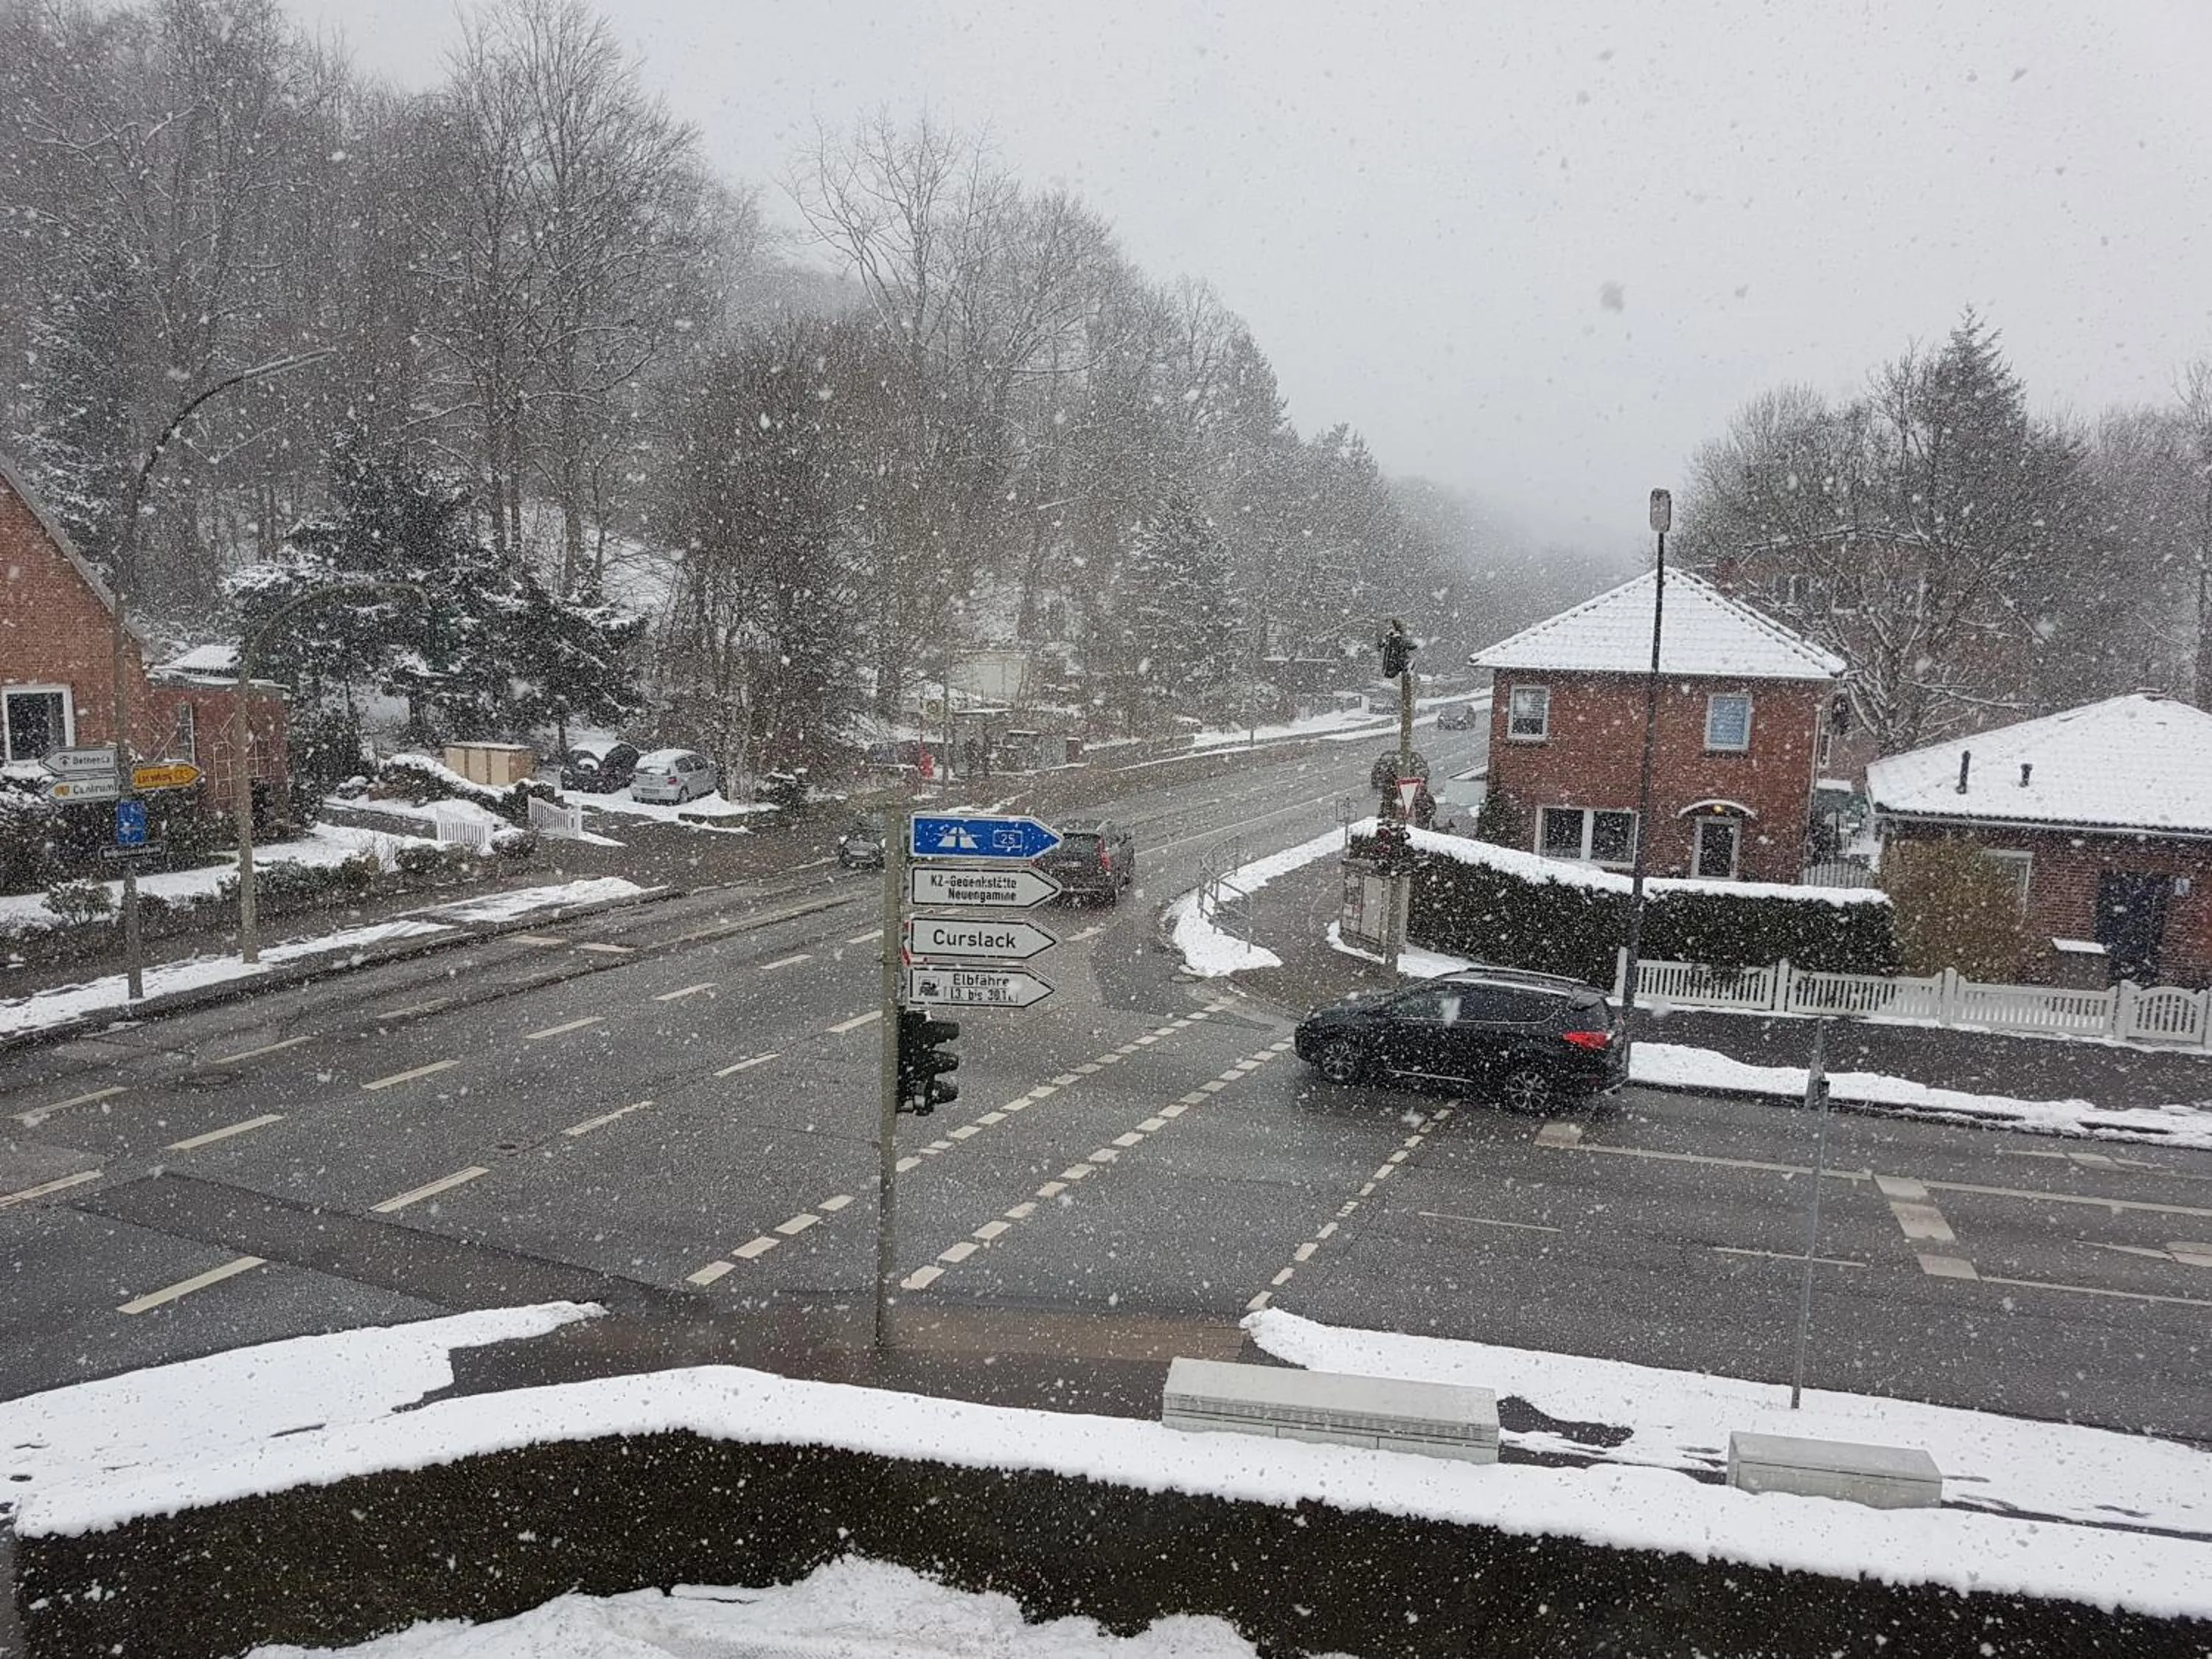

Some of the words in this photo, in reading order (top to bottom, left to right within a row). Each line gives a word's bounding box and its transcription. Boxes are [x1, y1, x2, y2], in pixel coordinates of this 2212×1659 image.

[1000, 833, 1015, 845] 25
[947, 888, 1017, 902] Neuengamme
[933, 929, 1016, 948] Curslack
[953, 973, 1009, 987] Elbfähre
[968, 989, 982, 1001] bis
